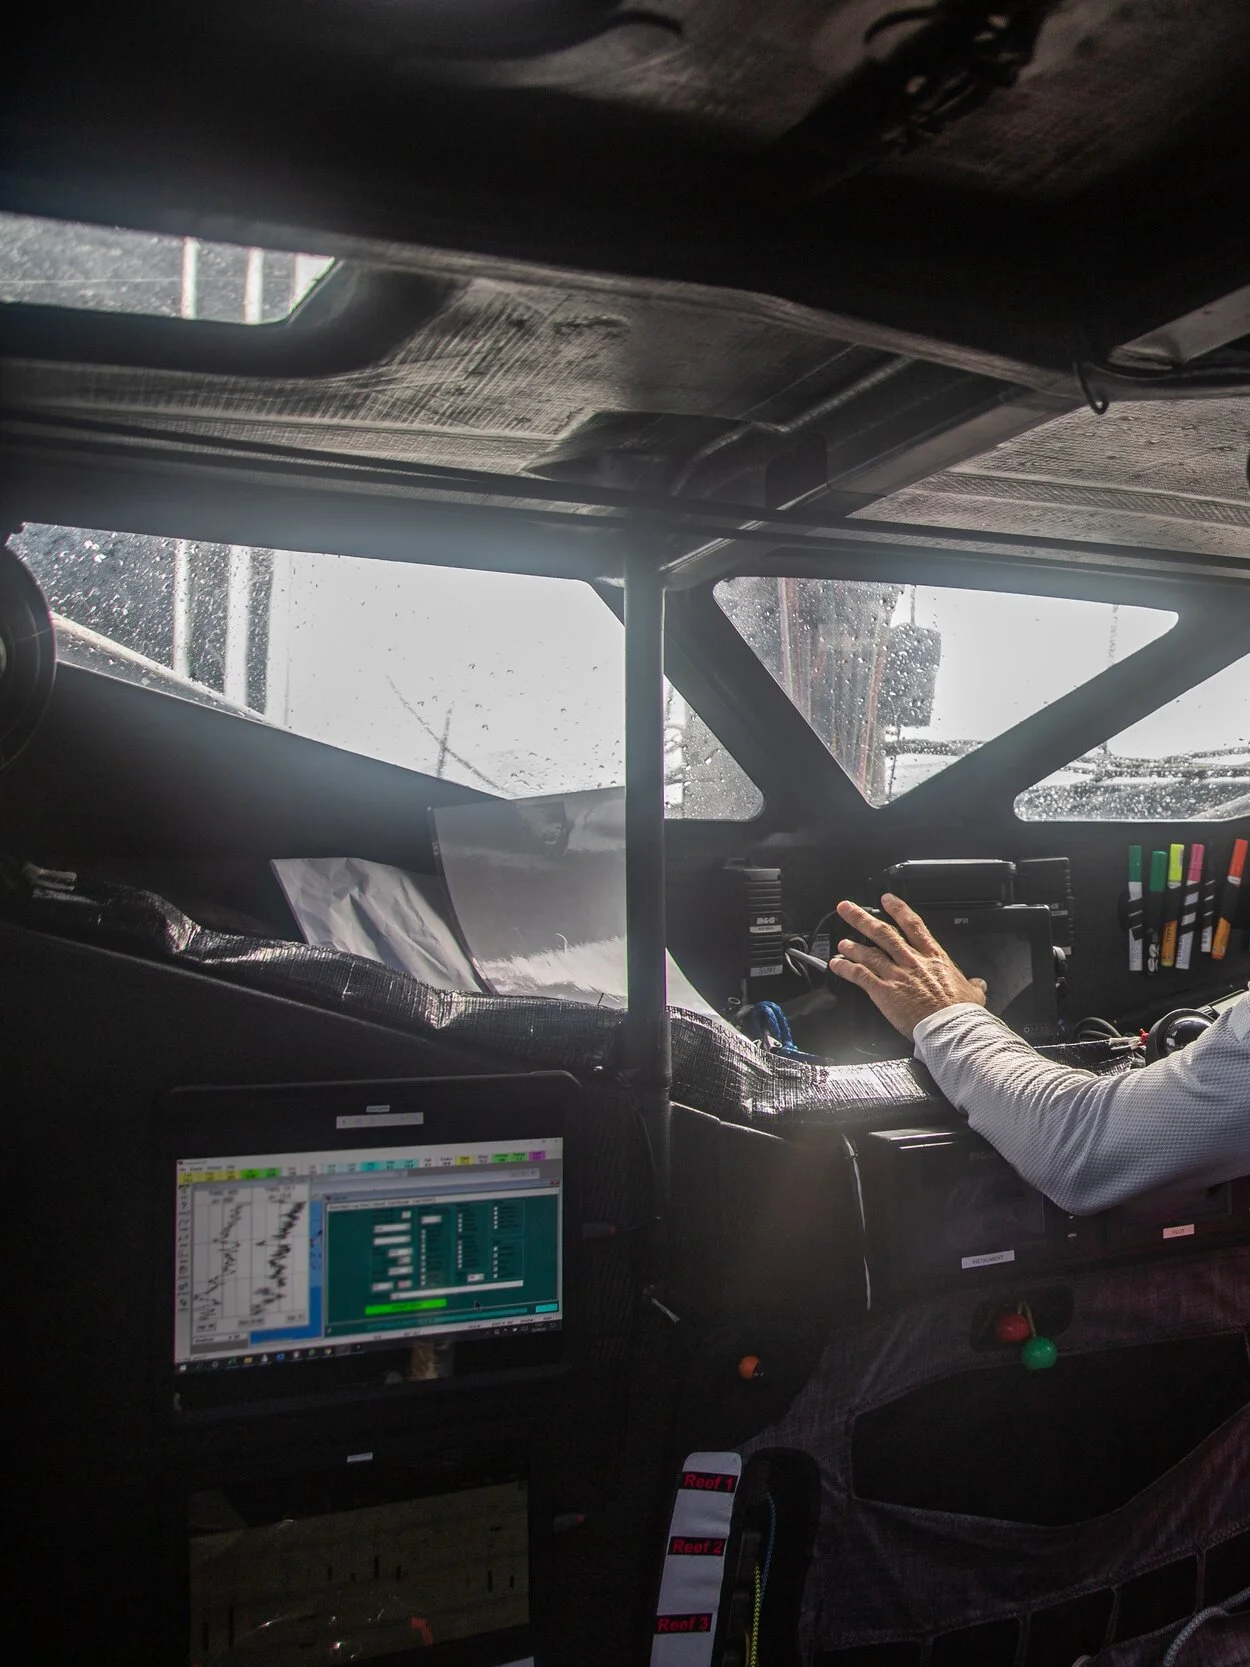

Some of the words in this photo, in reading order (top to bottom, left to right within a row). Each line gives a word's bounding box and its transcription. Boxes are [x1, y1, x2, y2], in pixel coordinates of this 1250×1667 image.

[971, 1254, 1004, 1265] INSTRUMENT
[684, 1473, 723, 1489] Reef
[726, 1476, 735, 1491] 1
[672, 1539, 710, 1553] Reef
[713, 1539, 725, 1554] 2
[656, 1616, 695, 1632] Reef
[698, 1615, 709, 1631] 3
